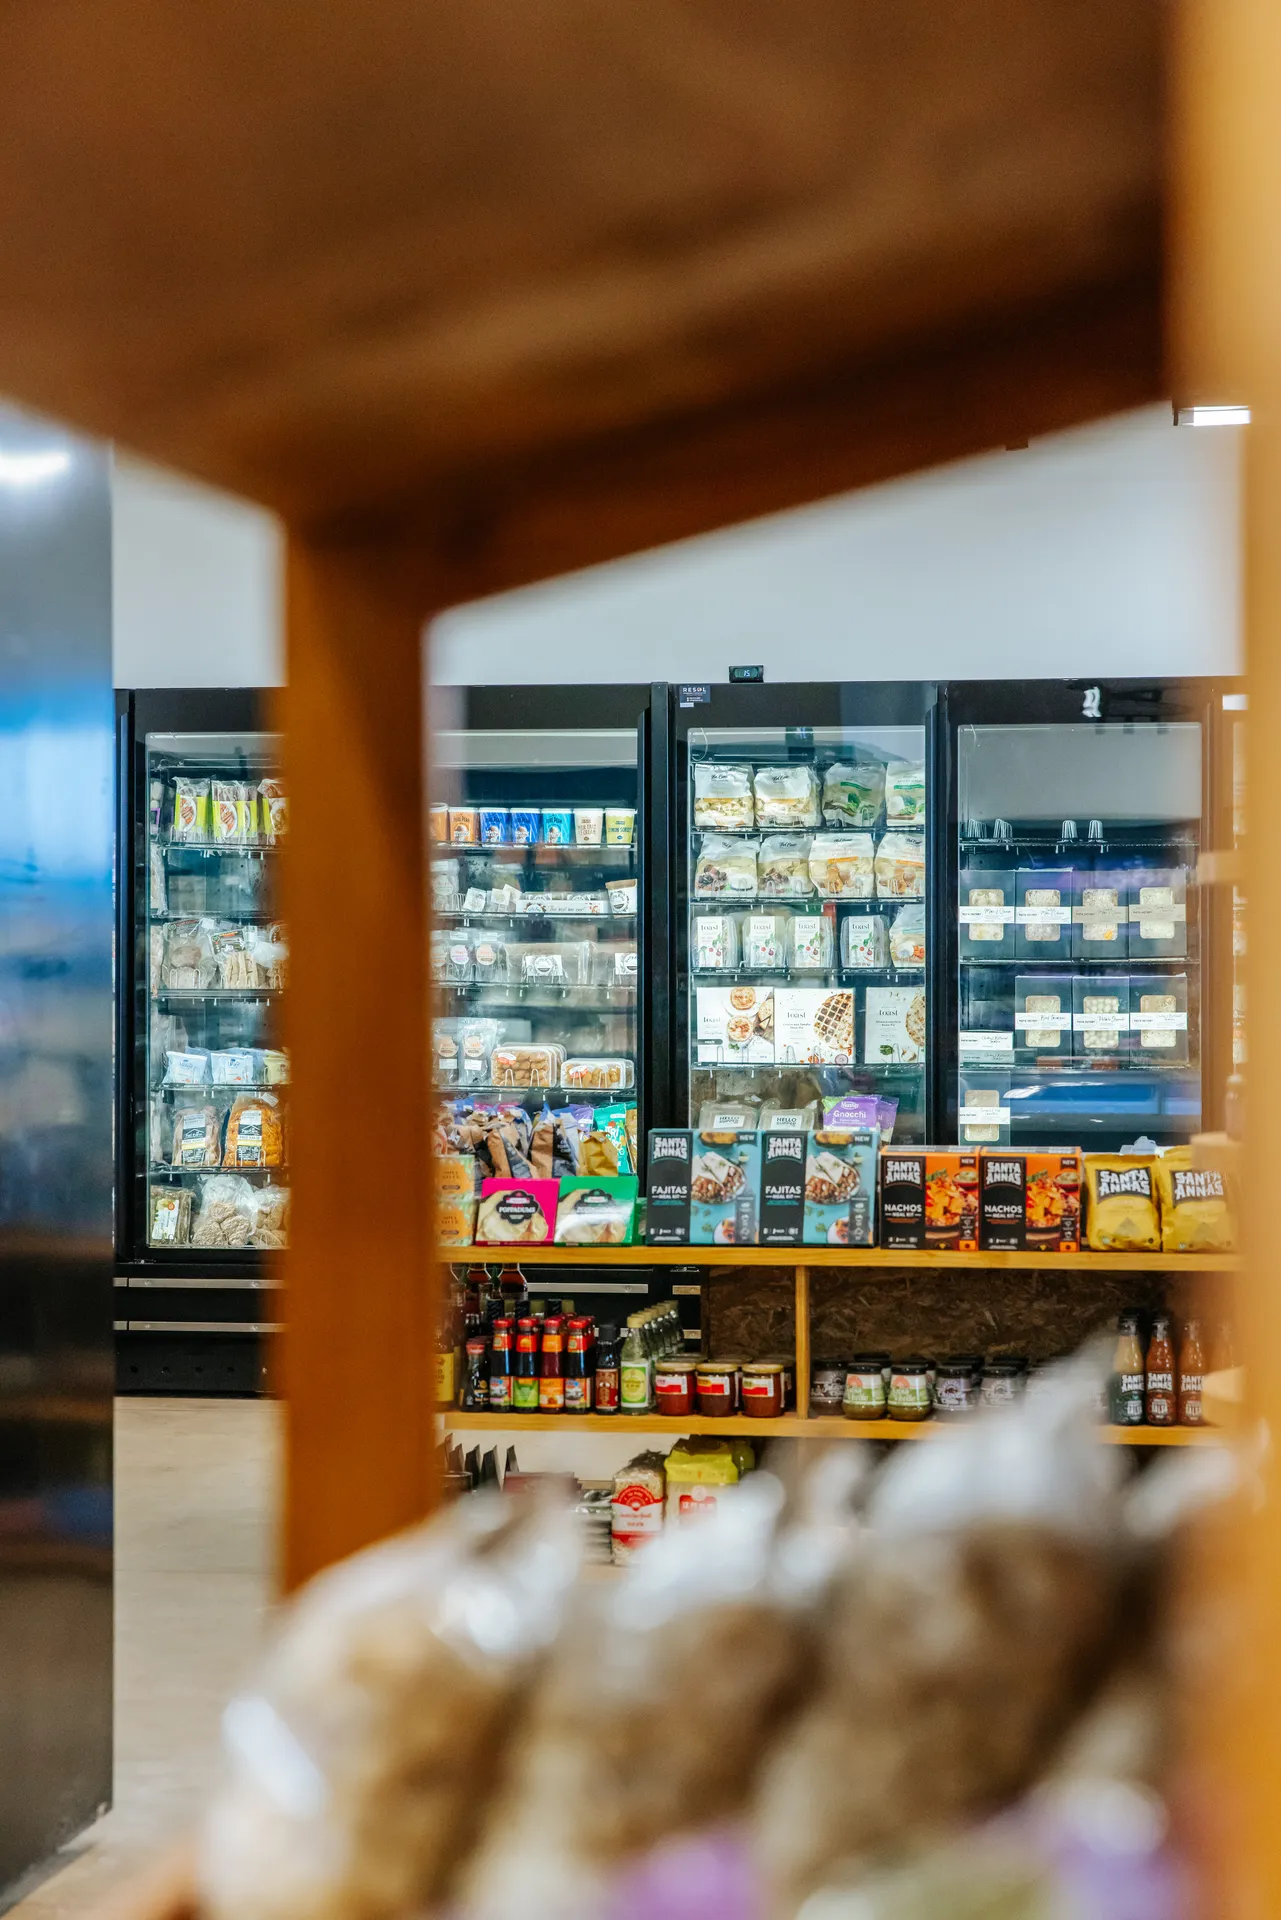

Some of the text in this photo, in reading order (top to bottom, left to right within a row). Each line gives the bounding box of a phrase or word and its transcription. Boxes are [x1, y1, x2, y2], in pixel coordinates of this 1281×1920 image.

[833, 1110, 867, 1119] Gnocchi
[654, 1137, 687, 1148] SANTA
[769, 1137, 801, 1147] SANTA
[653, 1147, 687, 1160] ANNAS
[768, 1146, 801, 1160] ANNAS
[886, 1161, 920, 1172] SANTA
[987, 1162, 1021, 1173] SANTA
[886, 1171, 920, 1185] ANNAS
[986, 1172, 1021, 1186] ANNAS
[1100, 1169, 1149, 1183] SANTA
[1174, 1171, 1221, 1185] SANTA
[651, 1186, 687, 1194] FAJITAS
[765, 1186, 801, 1194] FAJITAS
[1099, 1180, 1151, 1196] ANNAS
[1175, 1180, 1224, 1200] ANNAS
[884, 1204, 922, 1212] NACHOS
[984, 1205, 1023, 1213] NACHOS
[1148, 1372, 1172, 1382] SANTA
[1148, 1381, 1173, 1391] ANNAS
[1181, 1382, 1203, 1393] ANNA
